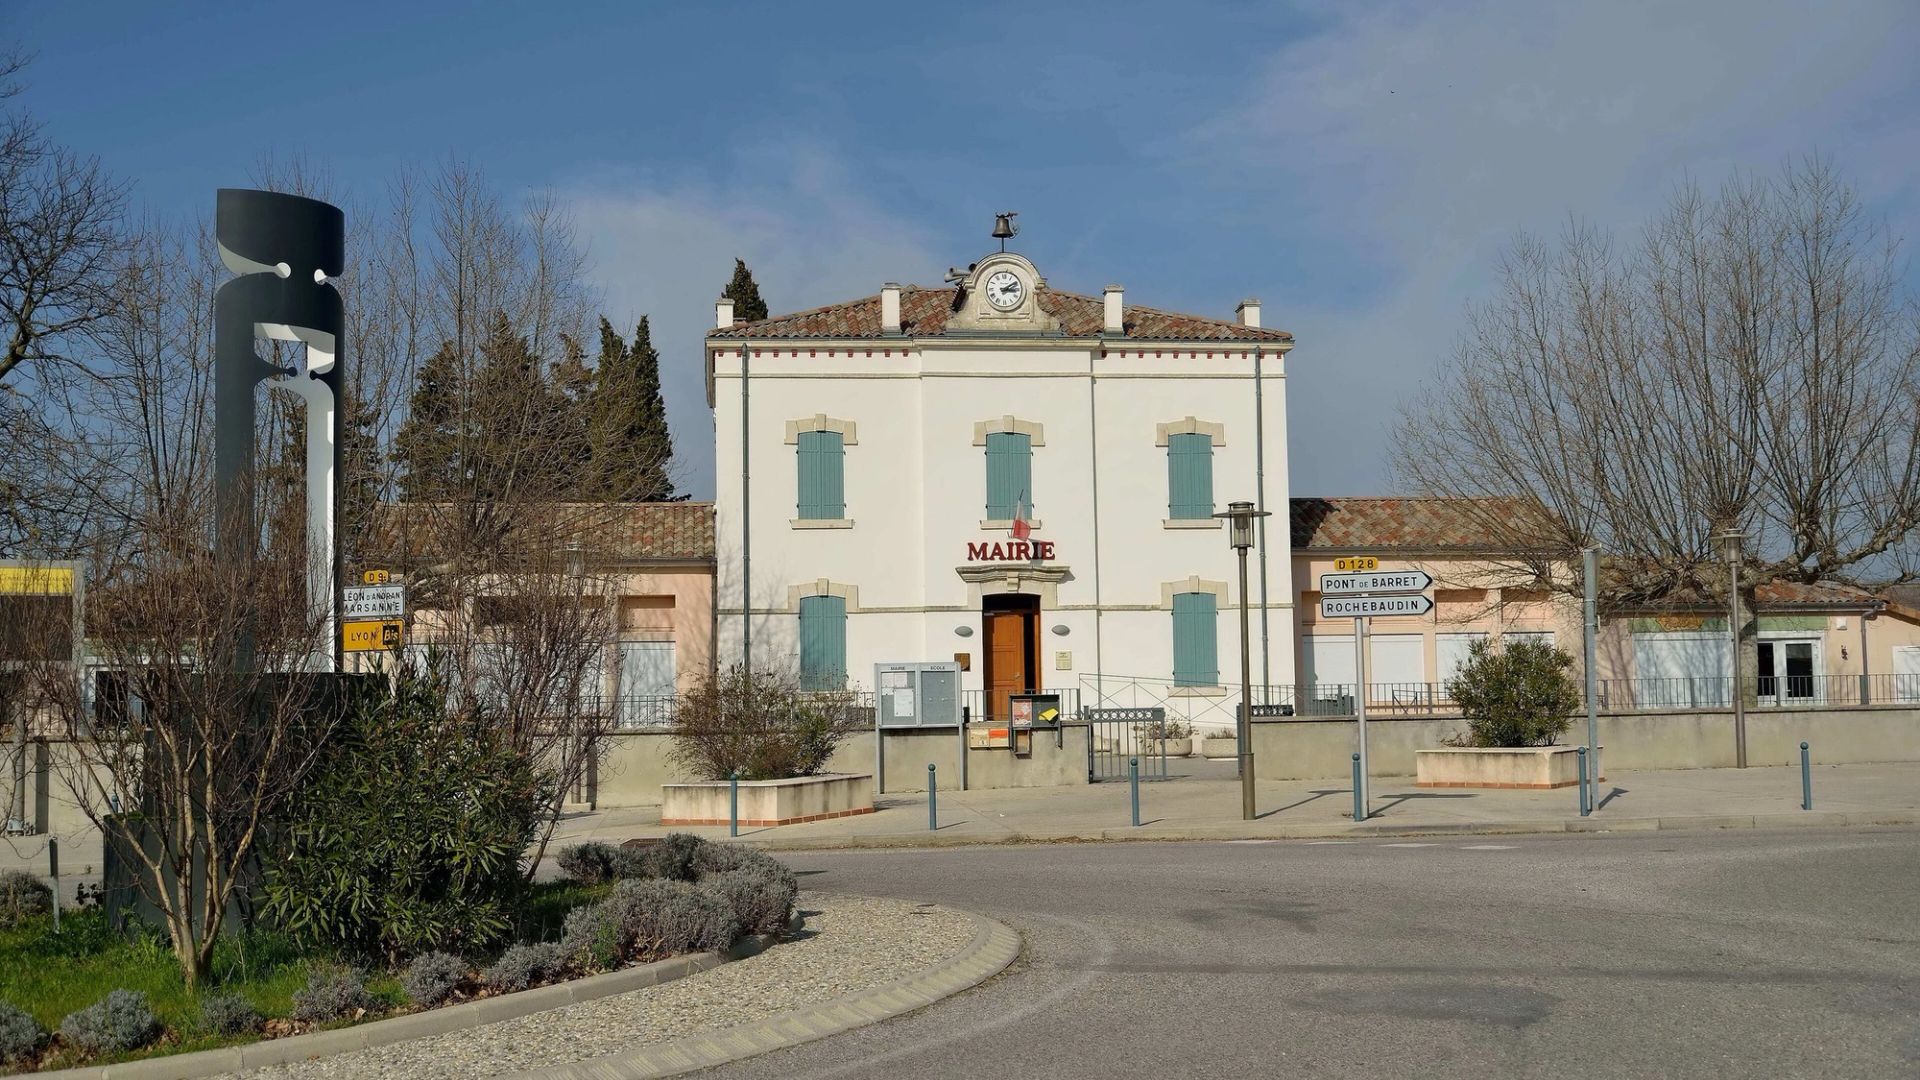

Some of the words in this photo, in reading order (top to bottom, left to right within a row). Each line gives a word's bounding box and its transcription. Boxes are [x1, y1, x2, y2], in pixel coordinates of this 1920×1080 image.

[967, 541, 1056, 561] MAIRIE
[1350, 559, 1374, 569] 128
[1326, 579, 1356, 589] PONT
[1372, 577, 1417, 588] BARRET
[1327, 600, 1418, 613] ROCHEBAUDIN
[351, 631, 377, 641] LYON
[384, 629, 399, 641] Bis
